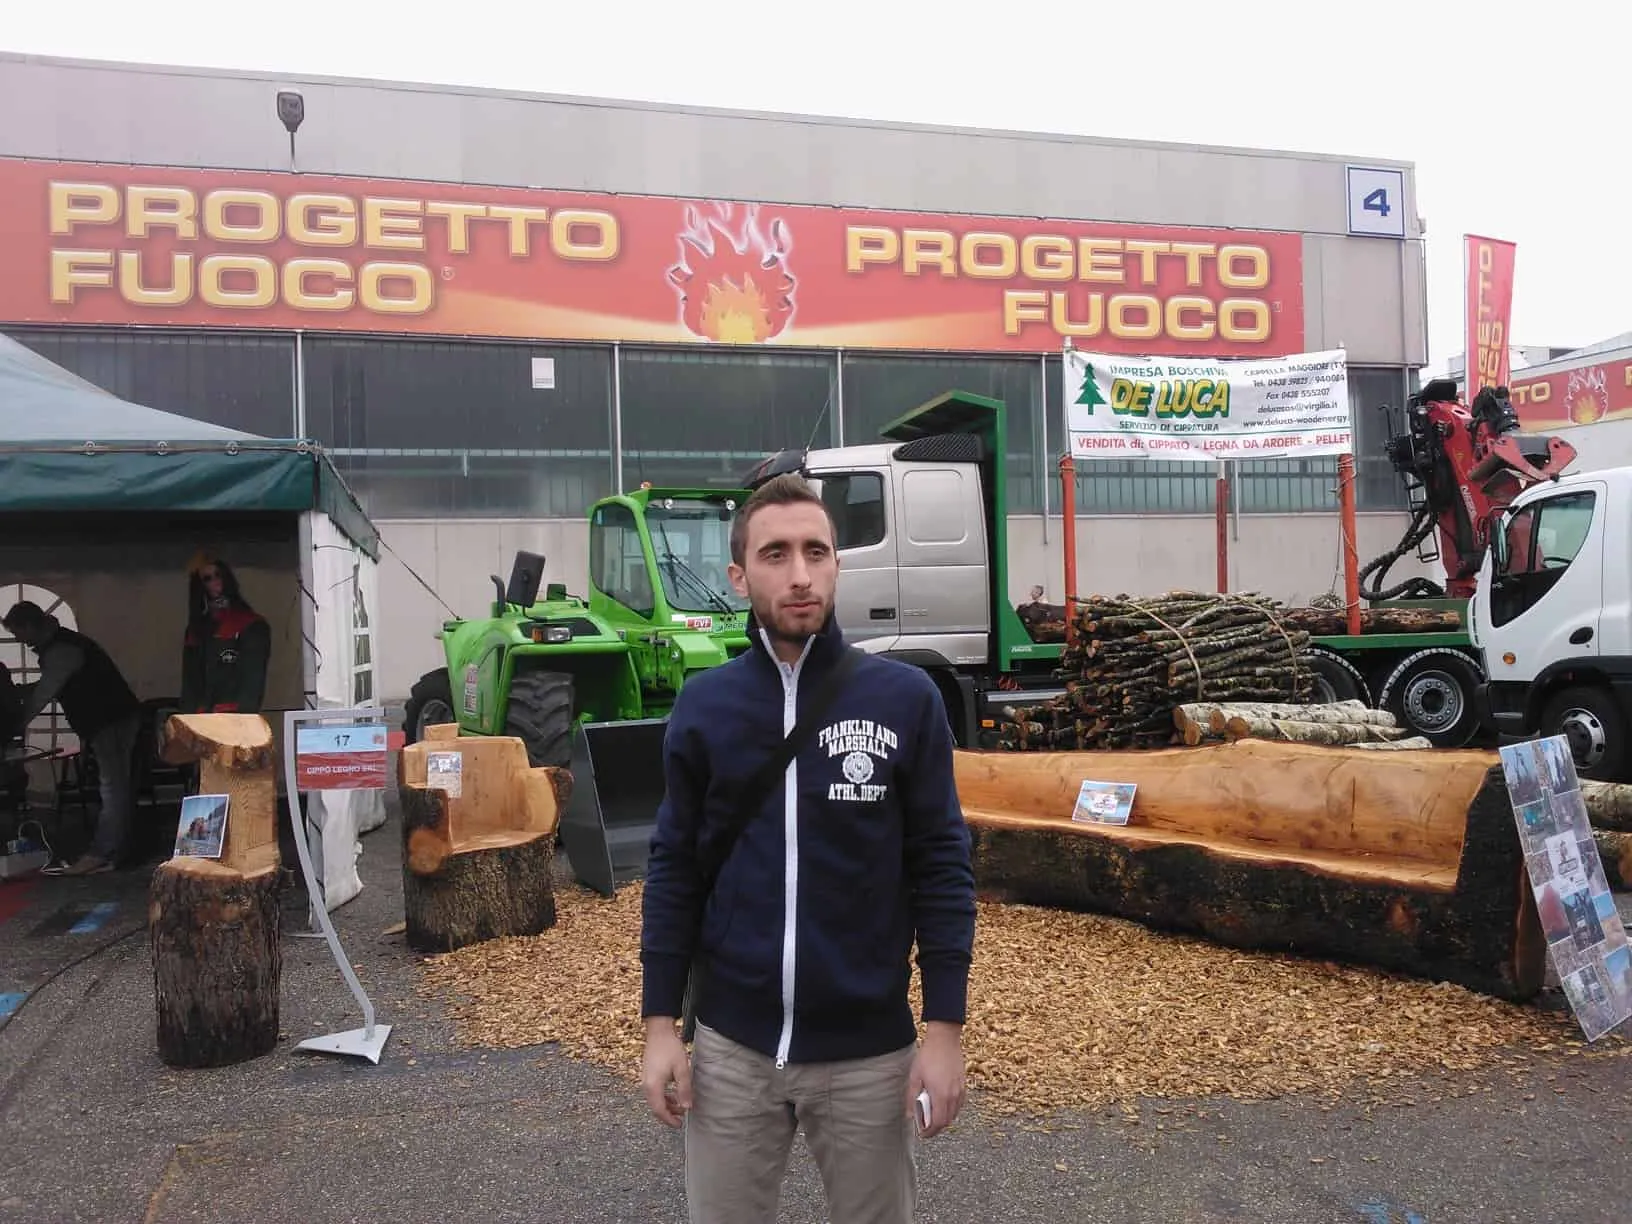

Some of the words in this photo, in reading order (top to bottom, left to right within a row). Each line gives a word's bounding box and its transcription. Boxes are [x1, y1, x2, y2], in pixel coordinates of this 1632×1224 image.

[1362, 187, 1393, 218] 4
[48, 180, 622, 262] PROGETTO
[846, 224, 1270, 291] PROGETTO
[49, 249, 436, 314] FUOCO
[1003, 289, 1272, 342] FUOCO
[1109, 365, 1164, 377] IMPRESA
[1110, 378, 1155, 418] DE
[1155, 379, 1231, 419] LUCA
[1119, 421, 1157, 431] SERVIZIO
[1160, 423, 1170, 432] DI
[1174, 423, 1219, 432] CIPPATURA
[1078, 438, 1126, 449] VENDITA
[1148, 439, 1190, 450] CIPPATO
[1203, 439, 1240, 451] LEGNA
[1243, 439, 1260, 449] DA
[1262, 436, 1303, 449] ARDERE
[333, 734, 351, 748] 17
[818, 719, 875, 748] FRANKLIN
[876, 723, 898, 750] AND
[828, 736, 888, 760] MARSHALL
[828, 783, 860, 801] ATHL.
[861, 783, 887, 801] DEPT
